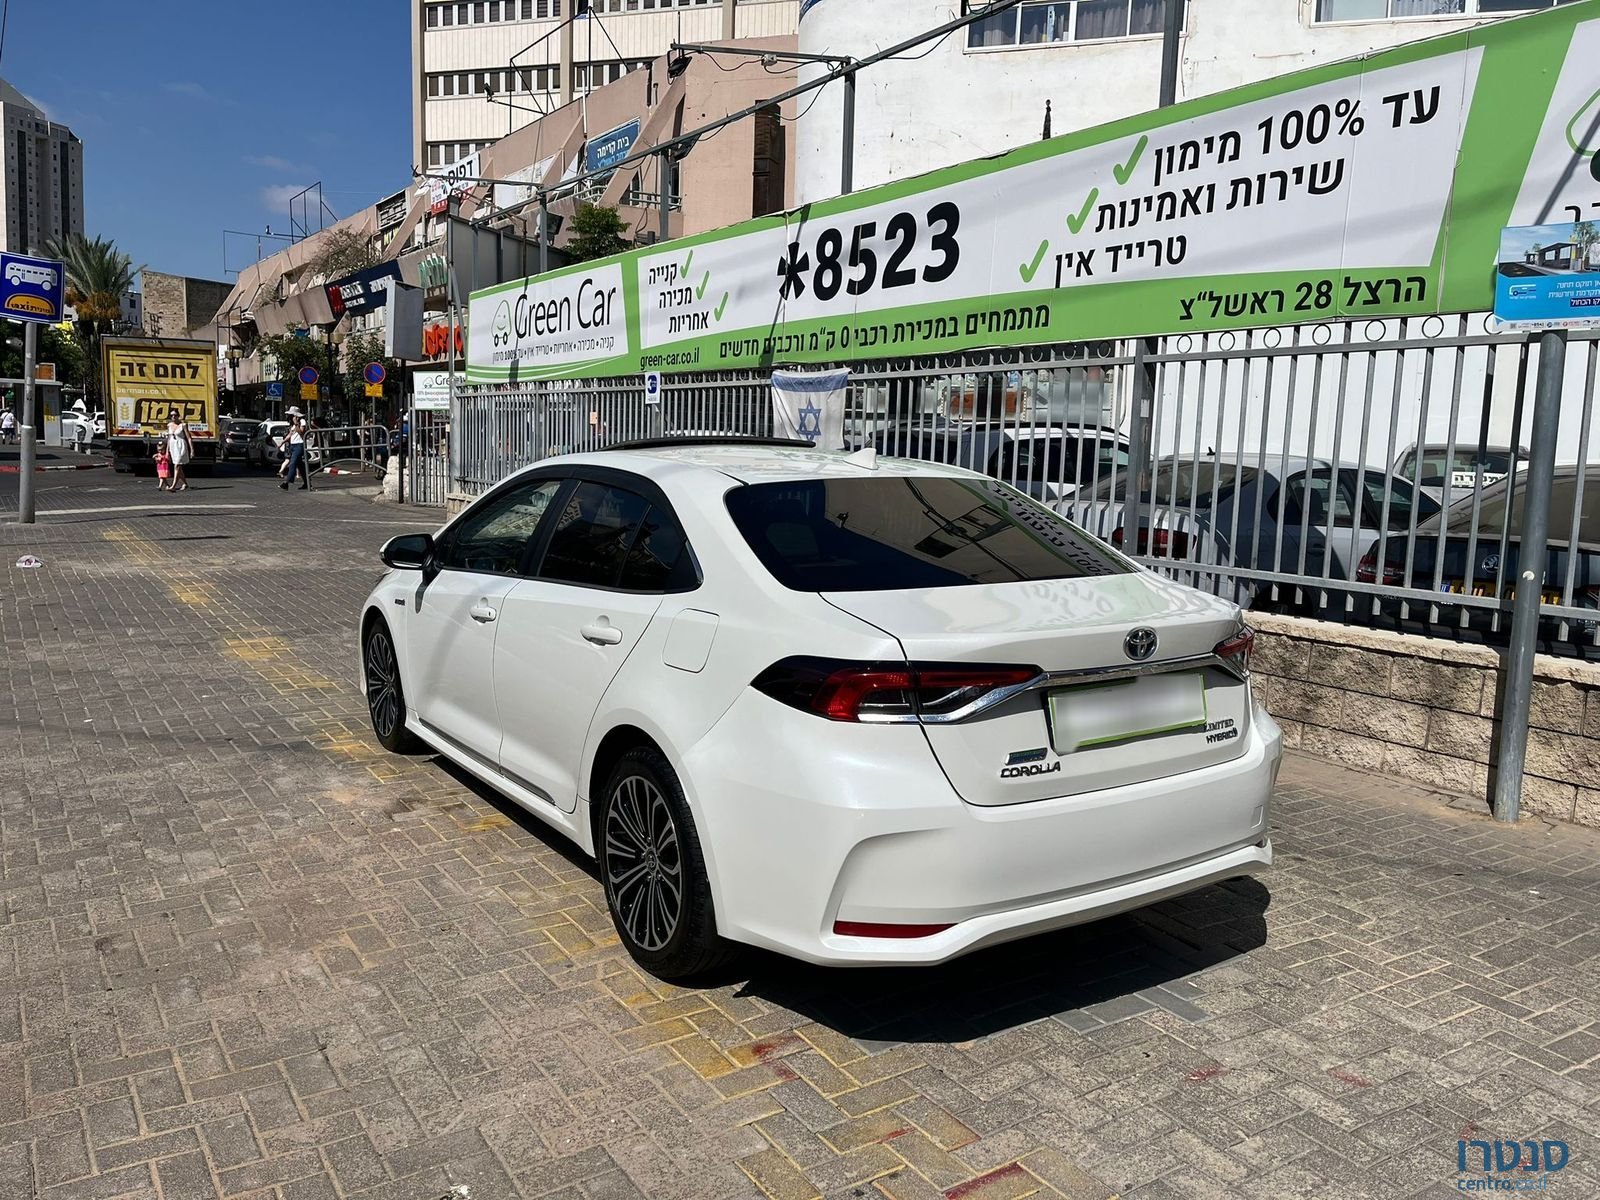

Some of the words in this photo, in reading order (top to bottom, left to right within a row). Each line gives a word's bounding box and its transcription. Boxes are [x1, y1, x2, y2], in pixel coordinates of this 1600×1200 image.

[1381, 85, 1440, 128] עד
[1257, 98, 1365, 156] 100%
[617, 136, 630, 150] בית
[1153, 130, 1241, 187] מימון
[1226, 158, 1345, 211] שירות
[1095, 186, 1215, 233] ואמינות
[1105, 234, 1187, 273] טרייד
[648, 262, 678, 286] קנייה
[1055, 247, 1096, 289] אין
[659, 286, 693, 309] מכירה
[1293, 279, 1334, 312] 28
[1343, 276, 1427, 307] הרצל
[514, 293, 571, 339] Green
[577, 278, 617, 329] Car
[966, 304, 1050, 335] מתמחים
[669, 311, 709, 334] אחריות
[892, 316, 959, 344] במכירת
[578, 338, 595, 351] מכירה
[600, 336, 614, 351] קניה
[720, 337, 759, 358] חדשים
[763, 334, 804, 354] ורכבים
[840, 325, 850, 349] 0
[854, 325, 887, 347] רכבי
[120, 361, 147, 377] זה
[154, 362, 200, 379] לחם
[640, 347, 700, 371] green-car.co.il
[140, 401, 202, 423] ברמן
[1206, 727, 1238, 744] HYBRID
[1000, 761, 1061, 778] COROLLA
